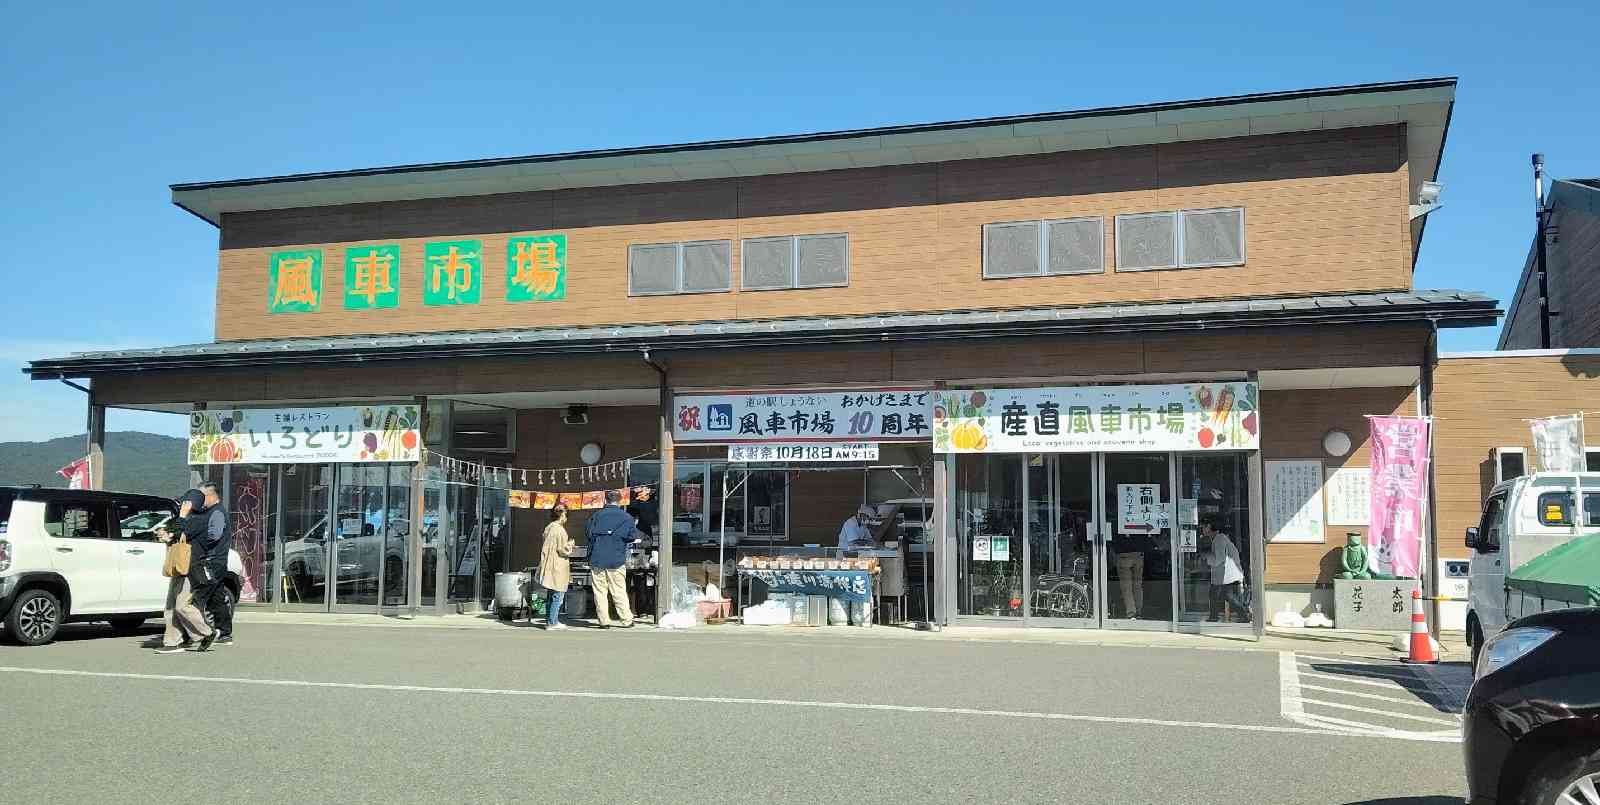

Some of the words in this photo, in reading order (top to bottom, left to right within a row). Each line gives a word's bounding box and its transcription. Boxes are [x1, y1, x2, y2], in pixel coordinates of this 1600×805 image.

[274, 238, 561, 307] 風車市場
[840, 391, 929, 408] おかげさまで
[678, 405, 701, 433] 祝
[737, 410, 836, 436] 風車市場
[1001, 400, 1185, 436] 産直風車市場
[248, 424, 353, 450] いろどり
[1352, 584, 1364, 613] 花子
[1392, 586, 1404, 613] 太郎
